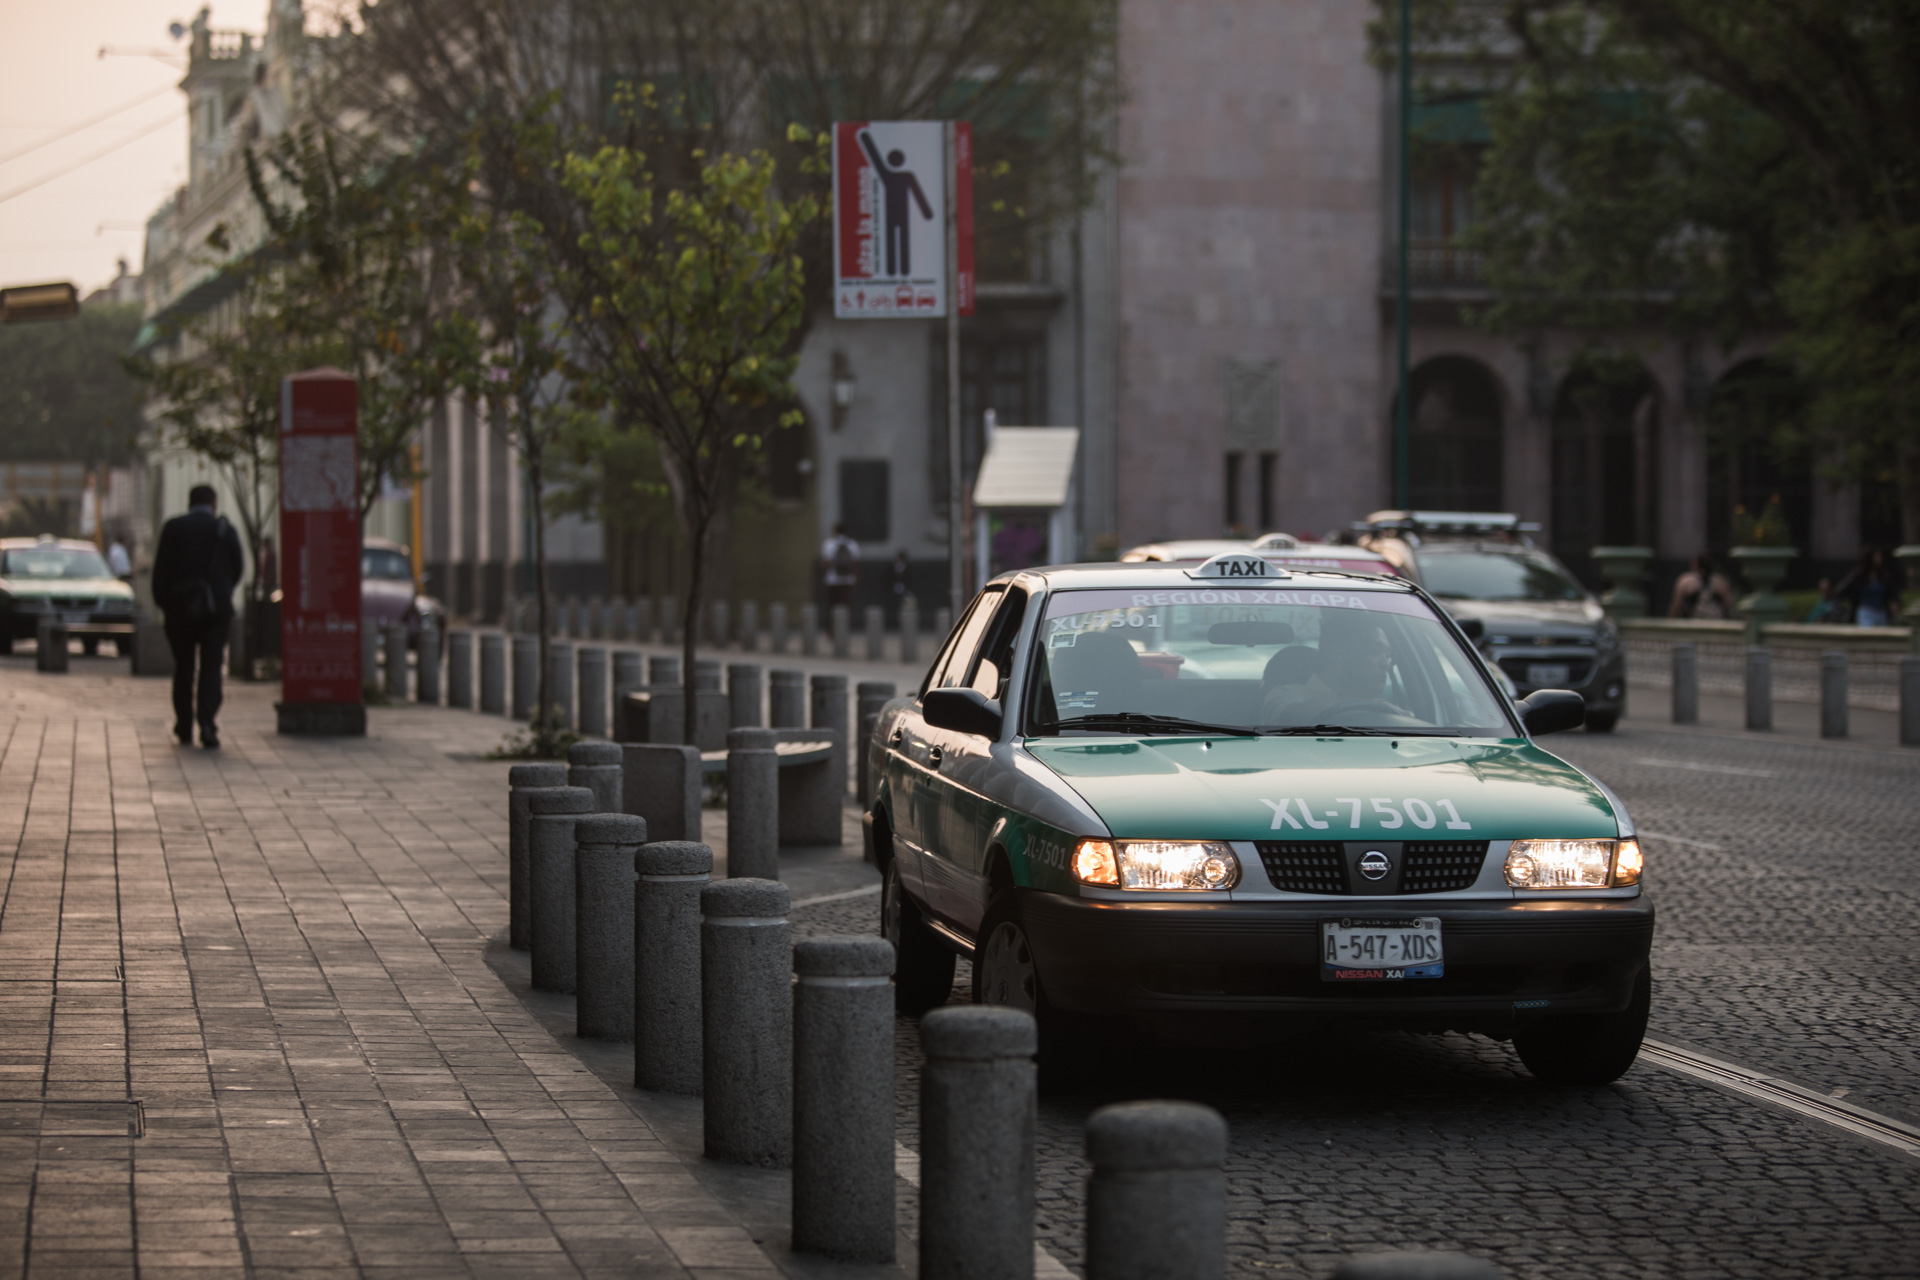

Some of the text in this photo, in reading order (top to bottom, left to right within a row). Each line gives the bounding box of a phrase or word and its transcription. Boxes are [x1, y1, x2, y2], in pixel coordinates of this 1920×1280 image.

[1216, 561, 1266, 576] TAXI
[1132, 590, 1366, 610] REGIÓN XALAPA
[1051, 613, 1162, 632] XL-7501
[1259, 798, 1472, 830] XL-7501
[1022, 833, 1066, 871] XL-7501
[1326, 935, 1439, 961] A-547-XDS
[1335, 970, 1384, 979] NISSAN
